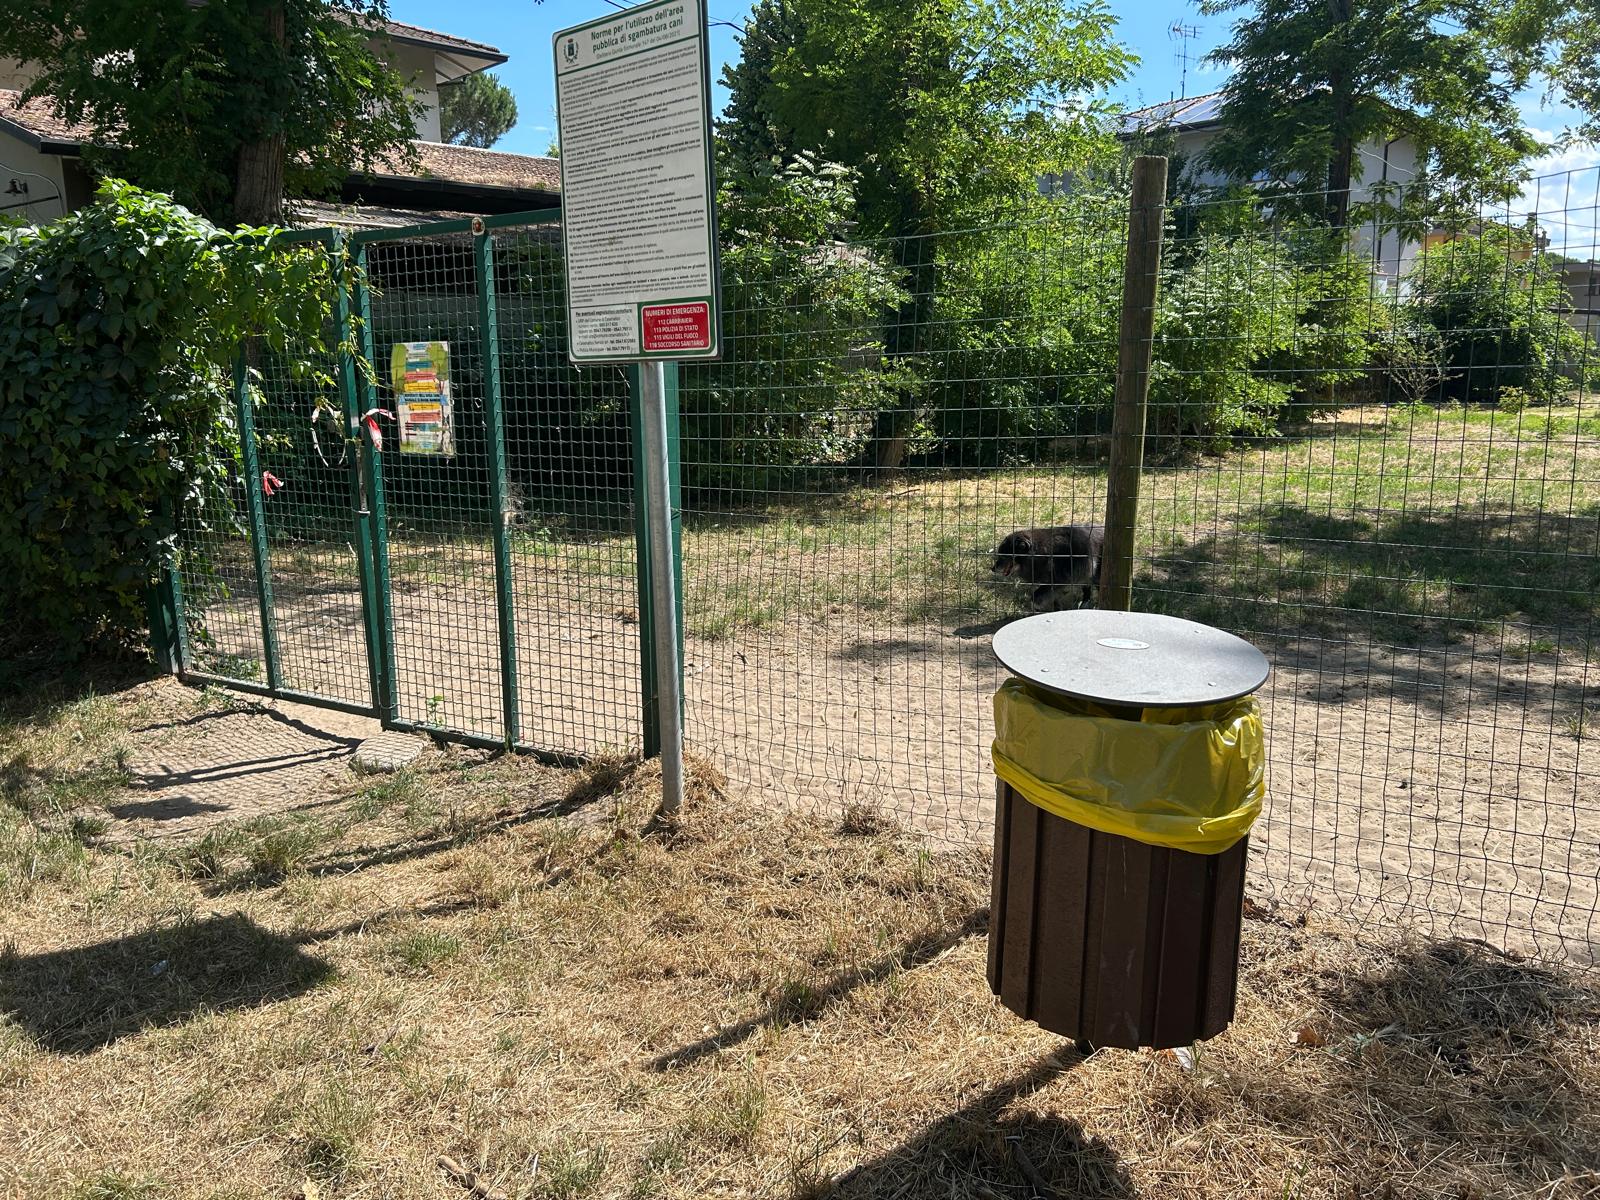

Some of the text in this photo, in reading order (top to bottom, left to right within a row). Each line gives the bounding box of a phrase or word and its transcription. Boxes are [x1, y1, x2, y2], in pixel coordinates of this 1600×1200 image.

[591, 5, 684, 41] Norme per l'utilizzo dell'area
[592, 16, 684, 53] pubblica di sgambatura cani
[645, 309, 665, 317] NUMERI
[666, 317, 693, 325] CARABINIERI
[657, 340, 680, 348] SOCCORSO
[680, 339, 704, 347] SANITARIO
